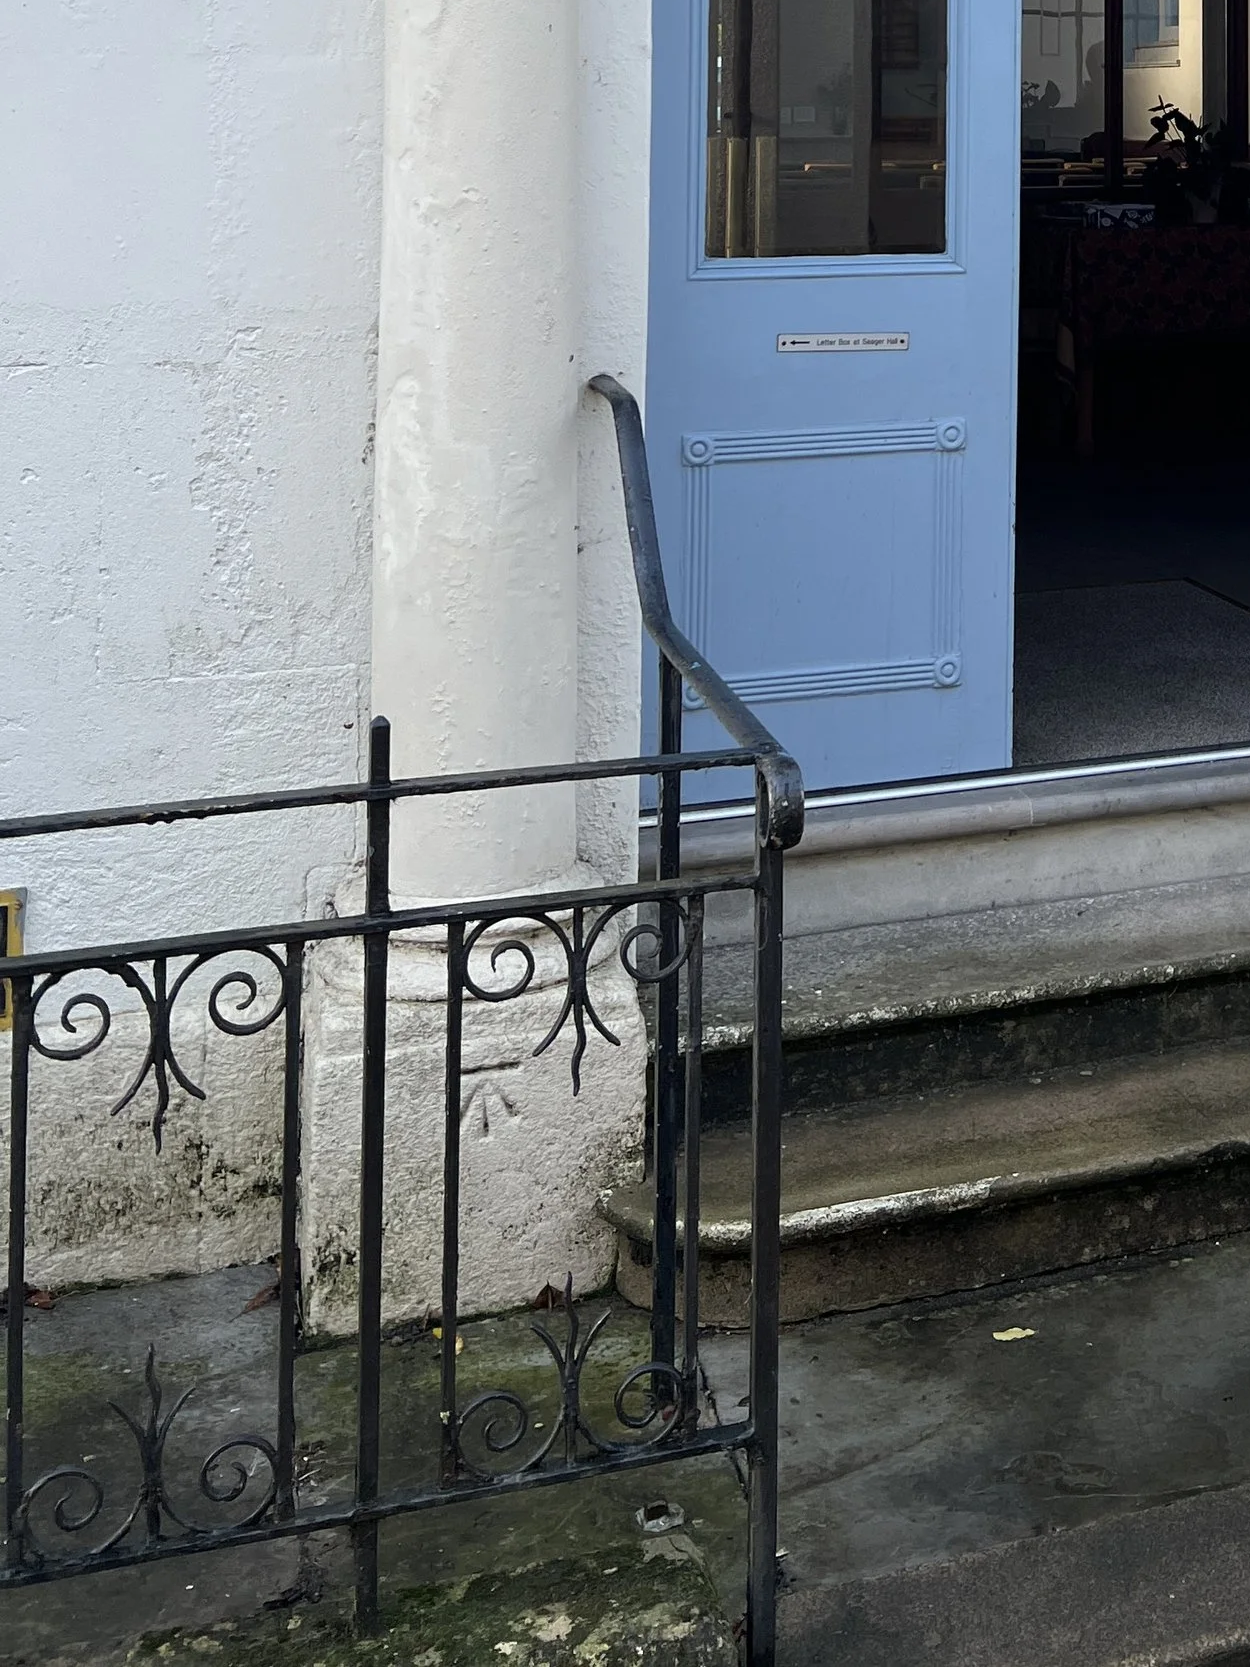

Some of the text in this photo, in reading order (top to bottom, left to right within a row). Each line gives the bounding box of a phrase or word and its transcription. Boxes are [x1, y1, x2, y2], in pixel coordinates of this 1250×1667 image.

[816, 338, 836, 347] Letter
[853, 338, 860, 346] at
[863, 337, 884, 347] Seager
[887, 337, 898, 345] Hall
